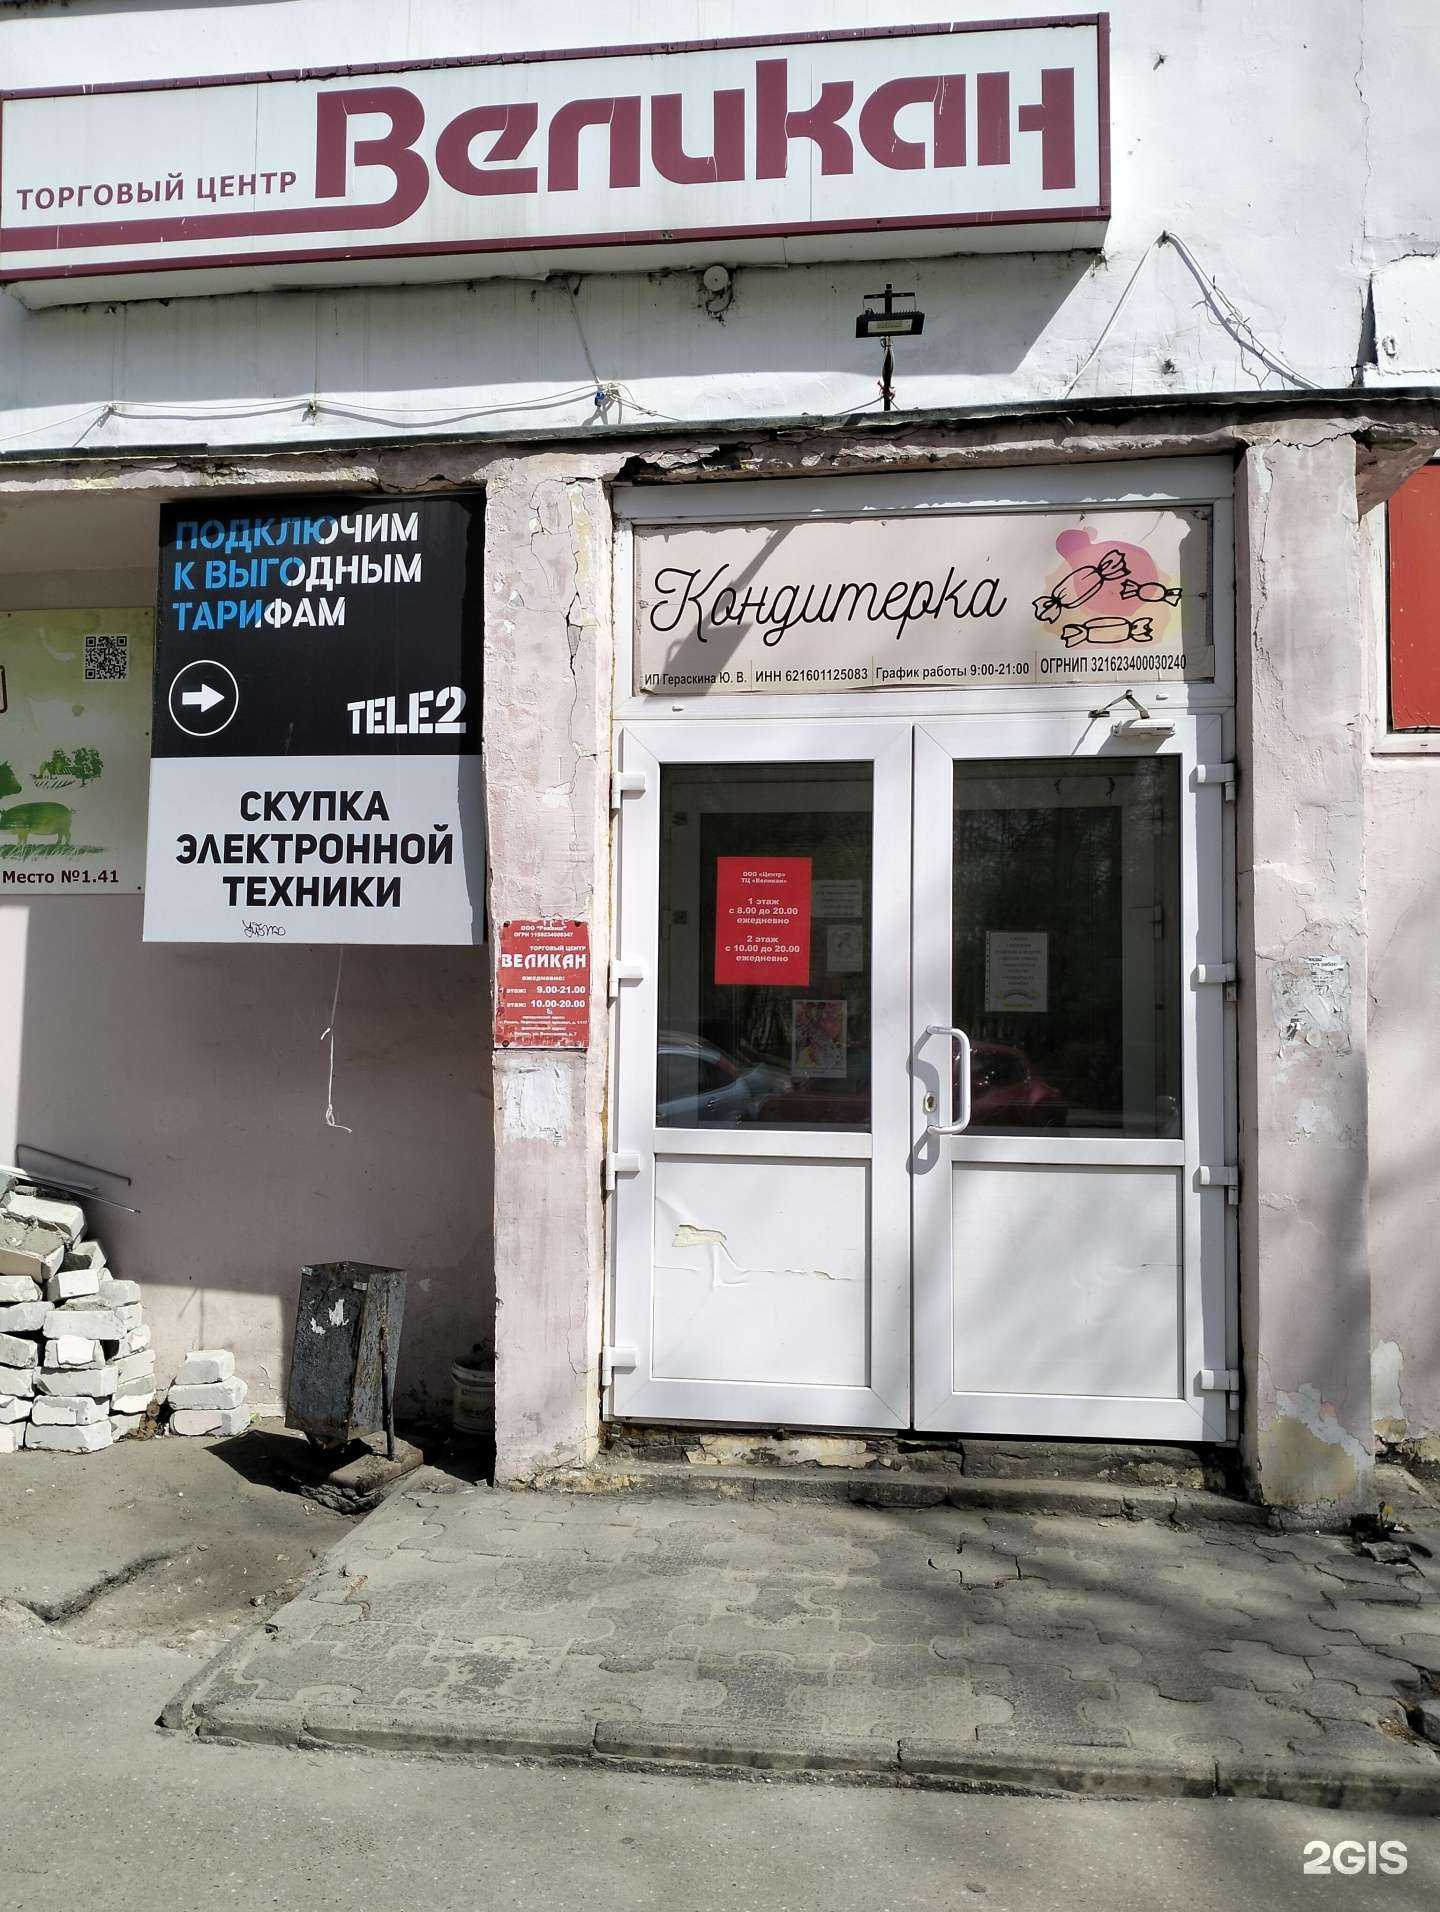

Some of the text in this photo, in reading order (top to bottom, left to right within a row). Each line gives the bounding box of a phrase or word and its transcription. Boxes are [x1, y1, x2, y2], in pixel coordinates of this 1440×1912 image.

[16, 171, 297, 210] ТОРГОВЫЙ ЦЕНТР
[176, 512, 420, 553] ПОДКЛЮЧИМ
[174, 553, 422, 592] К ВЫГОДНЫМ
[173, 596, 346, 631] ТАРИФАМ
[650, 563, 1008, 647] Кондитерка
[645, 654, 1187, 686] ИП Гераскина Ю. В. ИНН 621601125083 График работы 9:00-21:00 ОГРНИП 321623400030240
[347, 686, 467, 734] TELE2
[240, 790, 390, 821] СКУПКА
[176, 824, 454, 865] ЭЛЕКТРОННОЙ
[2, 869, 119, 883] Место №1.41
[223, 876, 401, 907] ТЕХНИКИ
[737, 907, 757, 915] 8.00
[759, 908, 771, 916] до
[773, 907, 799, 915] 20.00
[747, 897, 753, 905] 1
[734, 944, 759, 952] 10.00
[760, 946, 773, 954] до
[774, 945, 800, 953] 20.00
[746, 935, 753, 943] 2
[501, 953, 587, 969] ВЕЛИКАН
[531, 1000, 586, 1008] 10.00-20.00
[536, 985, 586, 994] 9.00-21.00
